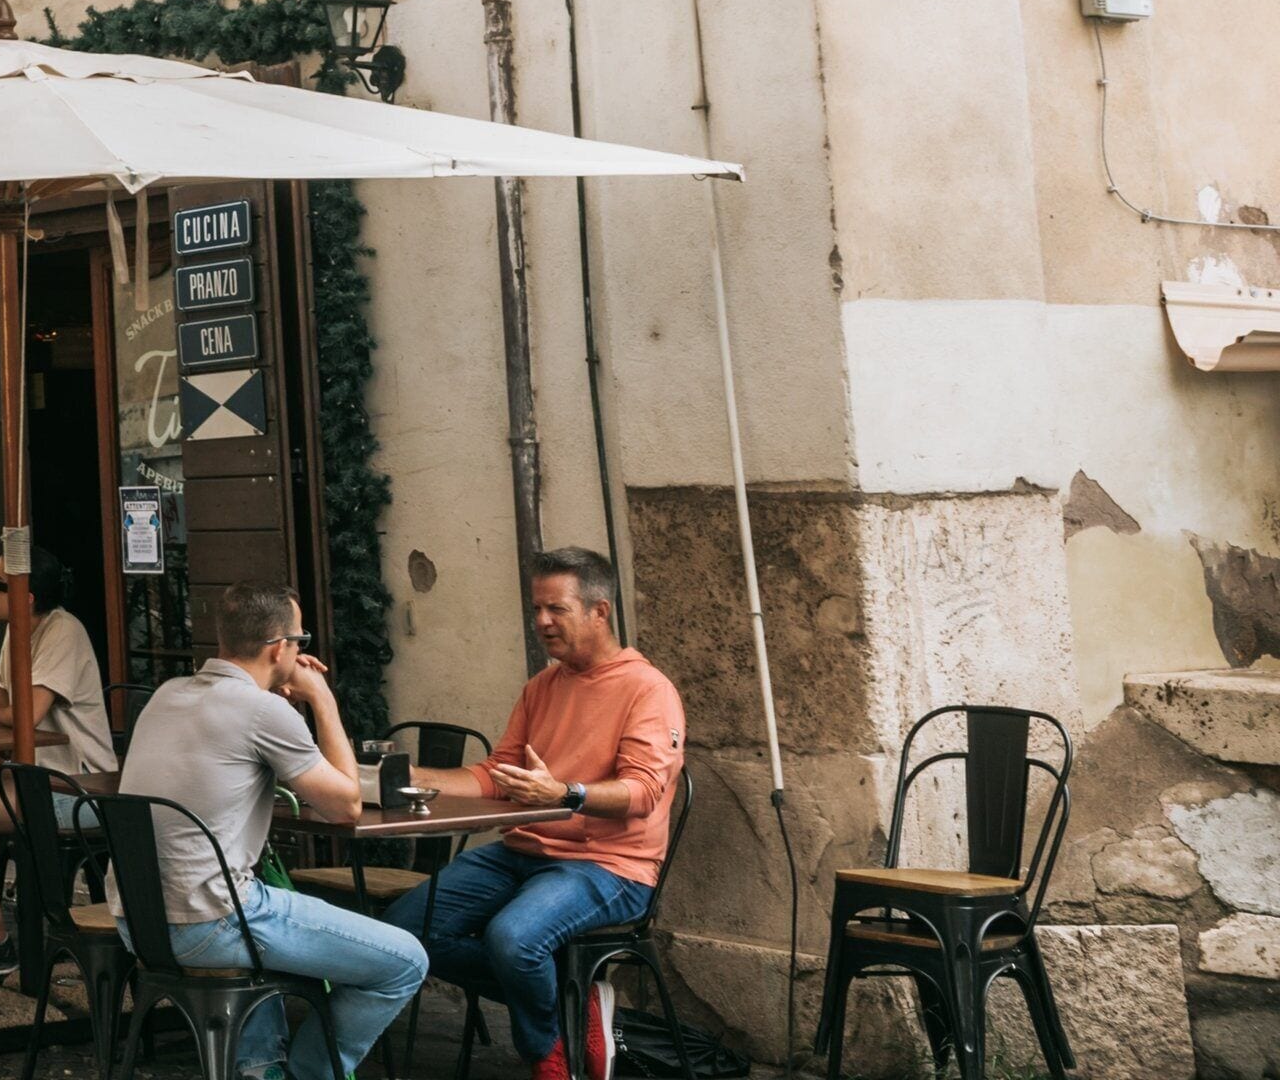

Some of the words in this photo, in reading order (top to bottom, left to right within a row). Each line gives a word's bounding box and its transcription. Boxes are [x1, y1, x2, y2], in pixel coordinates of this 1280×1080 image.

[183, 210, 241, 245] CUCINA
[189, 268, 238, 301] PRANZO
[125, 303, 164, 341] SNACK
[200, 325, 233, 356] CENA
